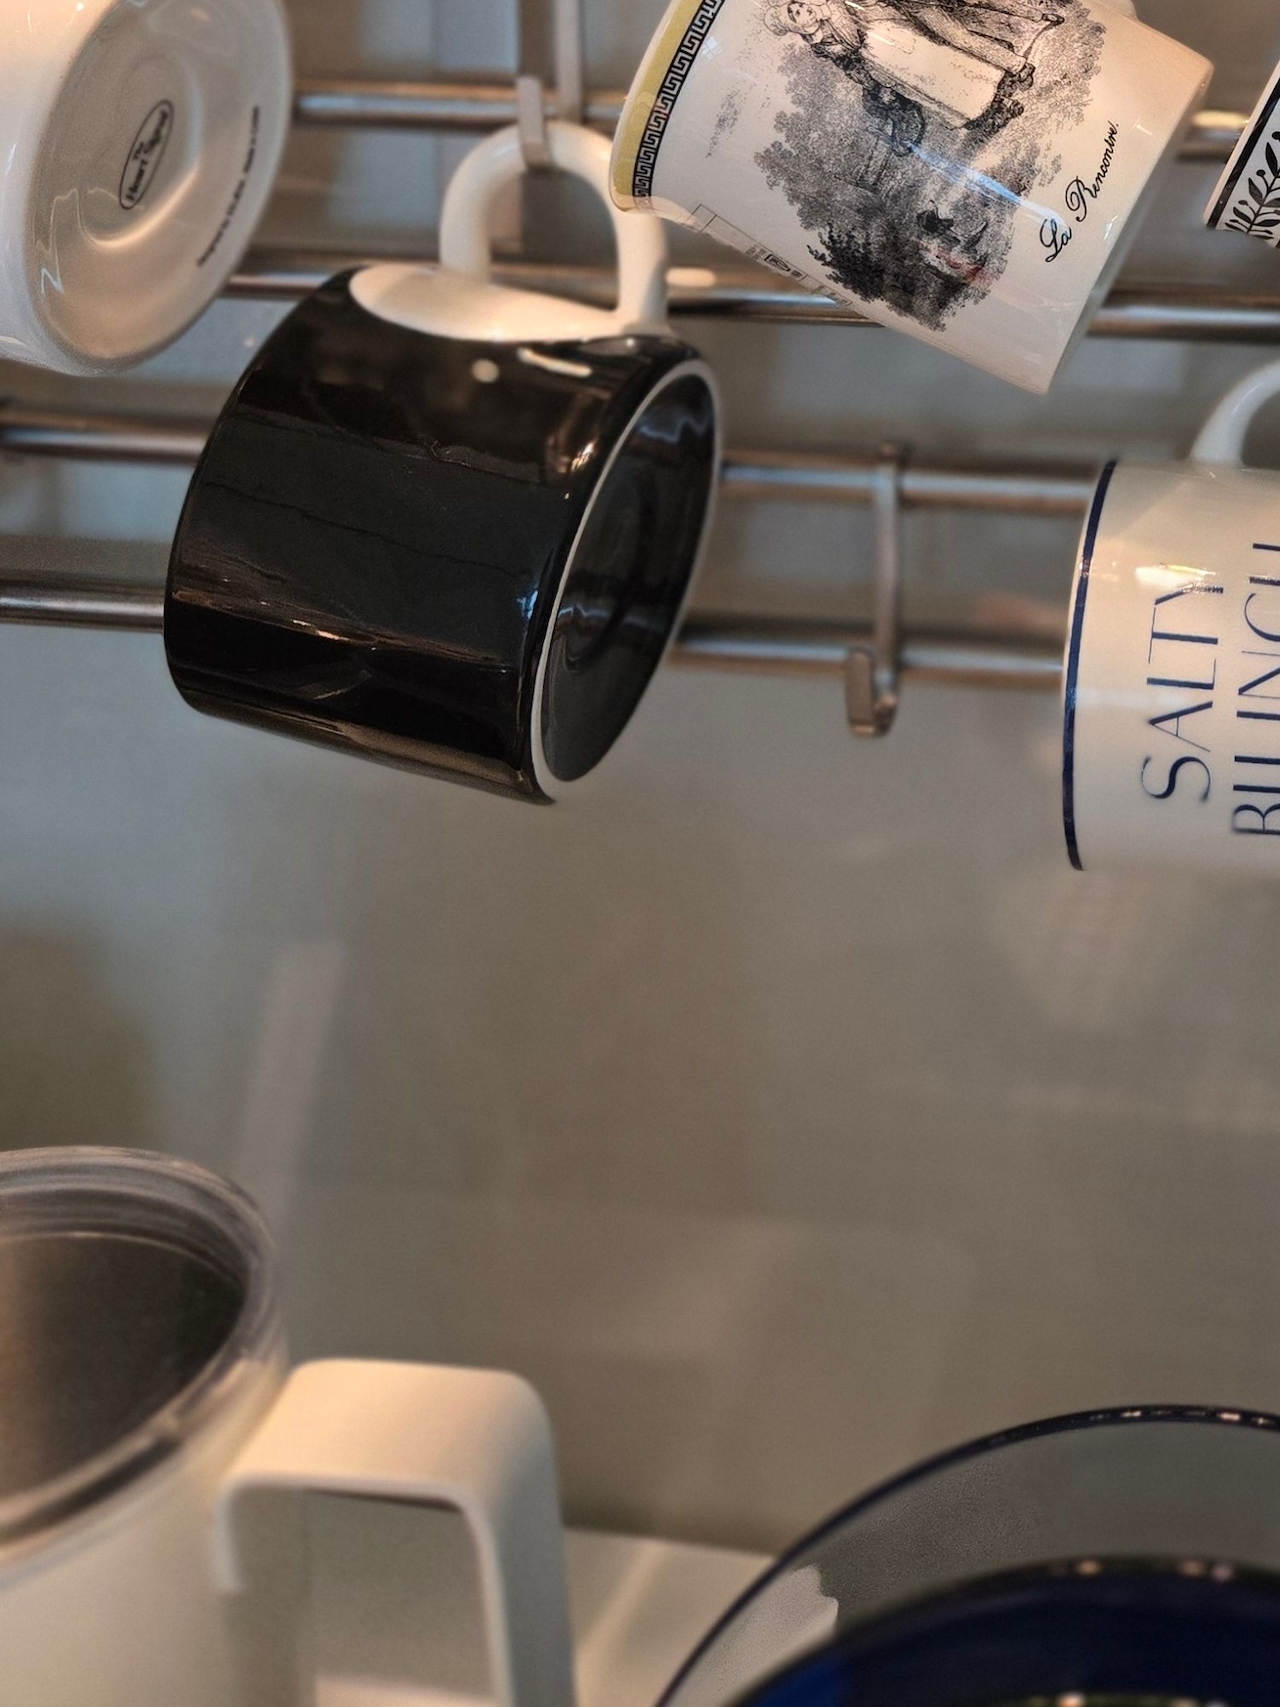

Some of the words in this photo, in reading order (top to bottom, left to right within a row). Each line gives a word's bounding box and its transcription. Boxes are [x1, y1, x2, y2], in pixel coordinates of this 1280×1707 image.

[126, 159, 148, 202] Heart
[1039, 218, 1072, 263] La
[1141, 563, 1224, 802] SALTY
